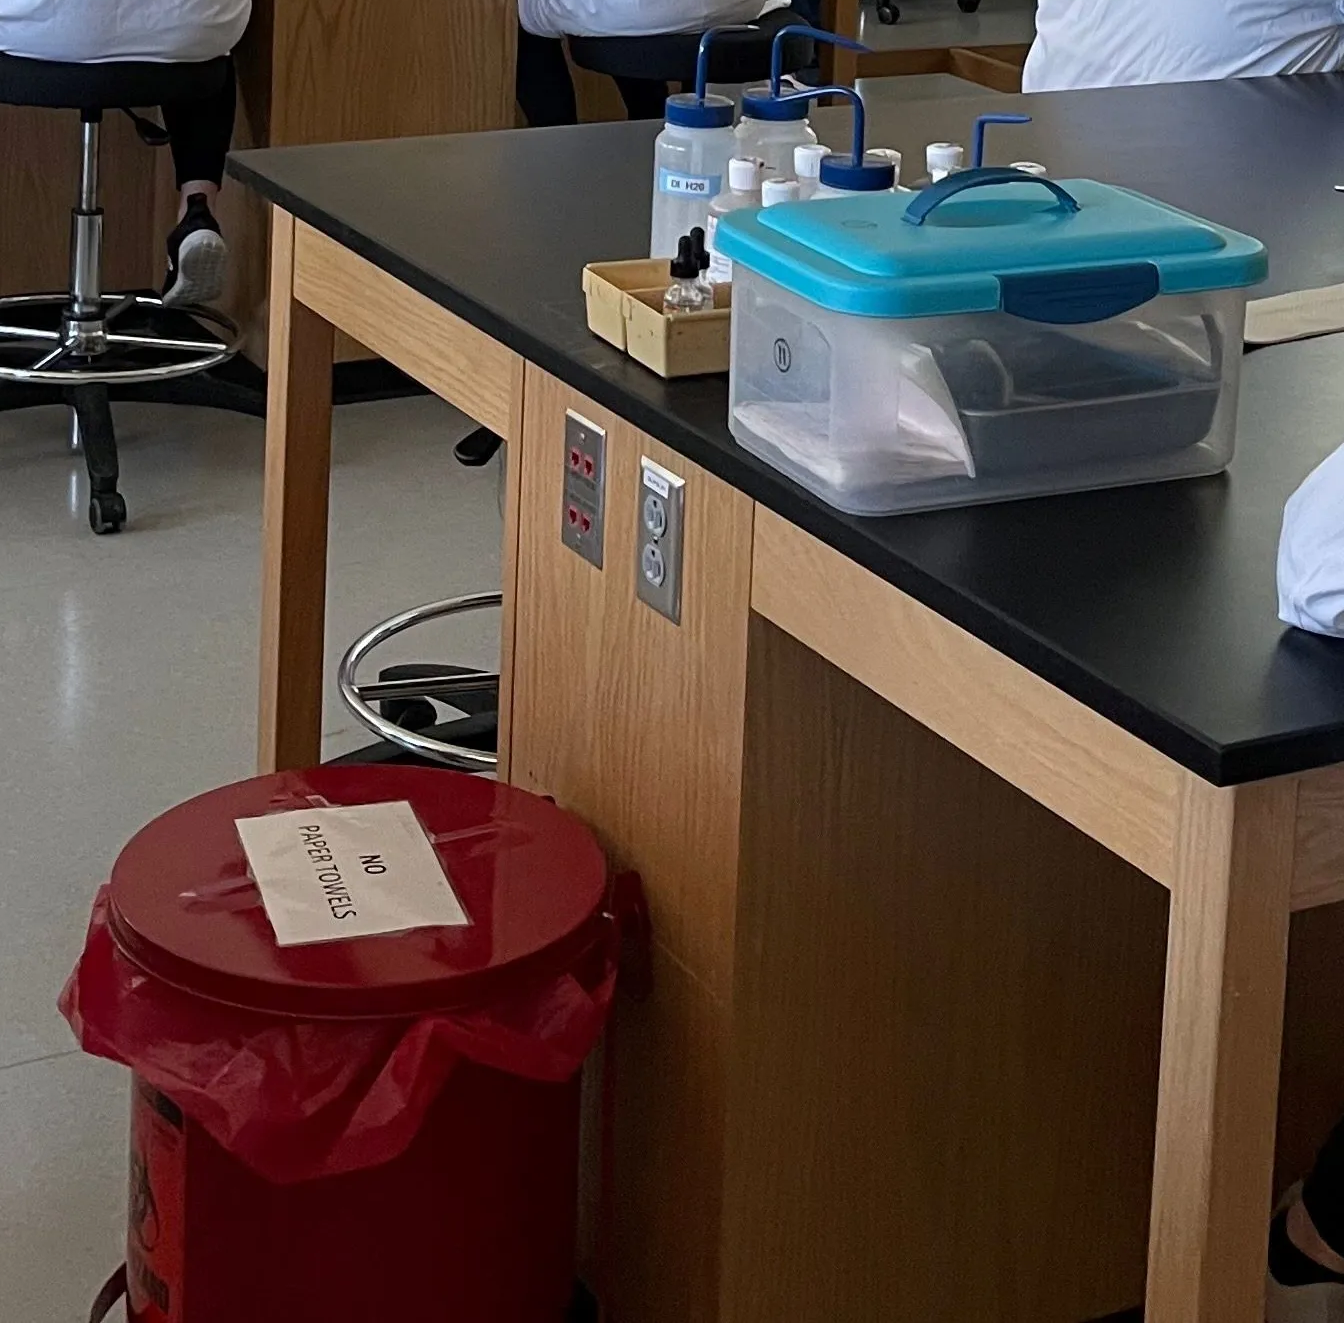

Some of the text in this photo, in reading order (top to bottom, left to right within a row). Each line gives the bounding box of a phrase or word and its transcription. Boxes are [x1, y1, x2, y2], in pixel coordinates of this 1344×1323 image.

[670, 179, 681, 189] DI
[298, 824, 357, 921] PAPER TOWELS
[359, 853, 387, 875] NO
